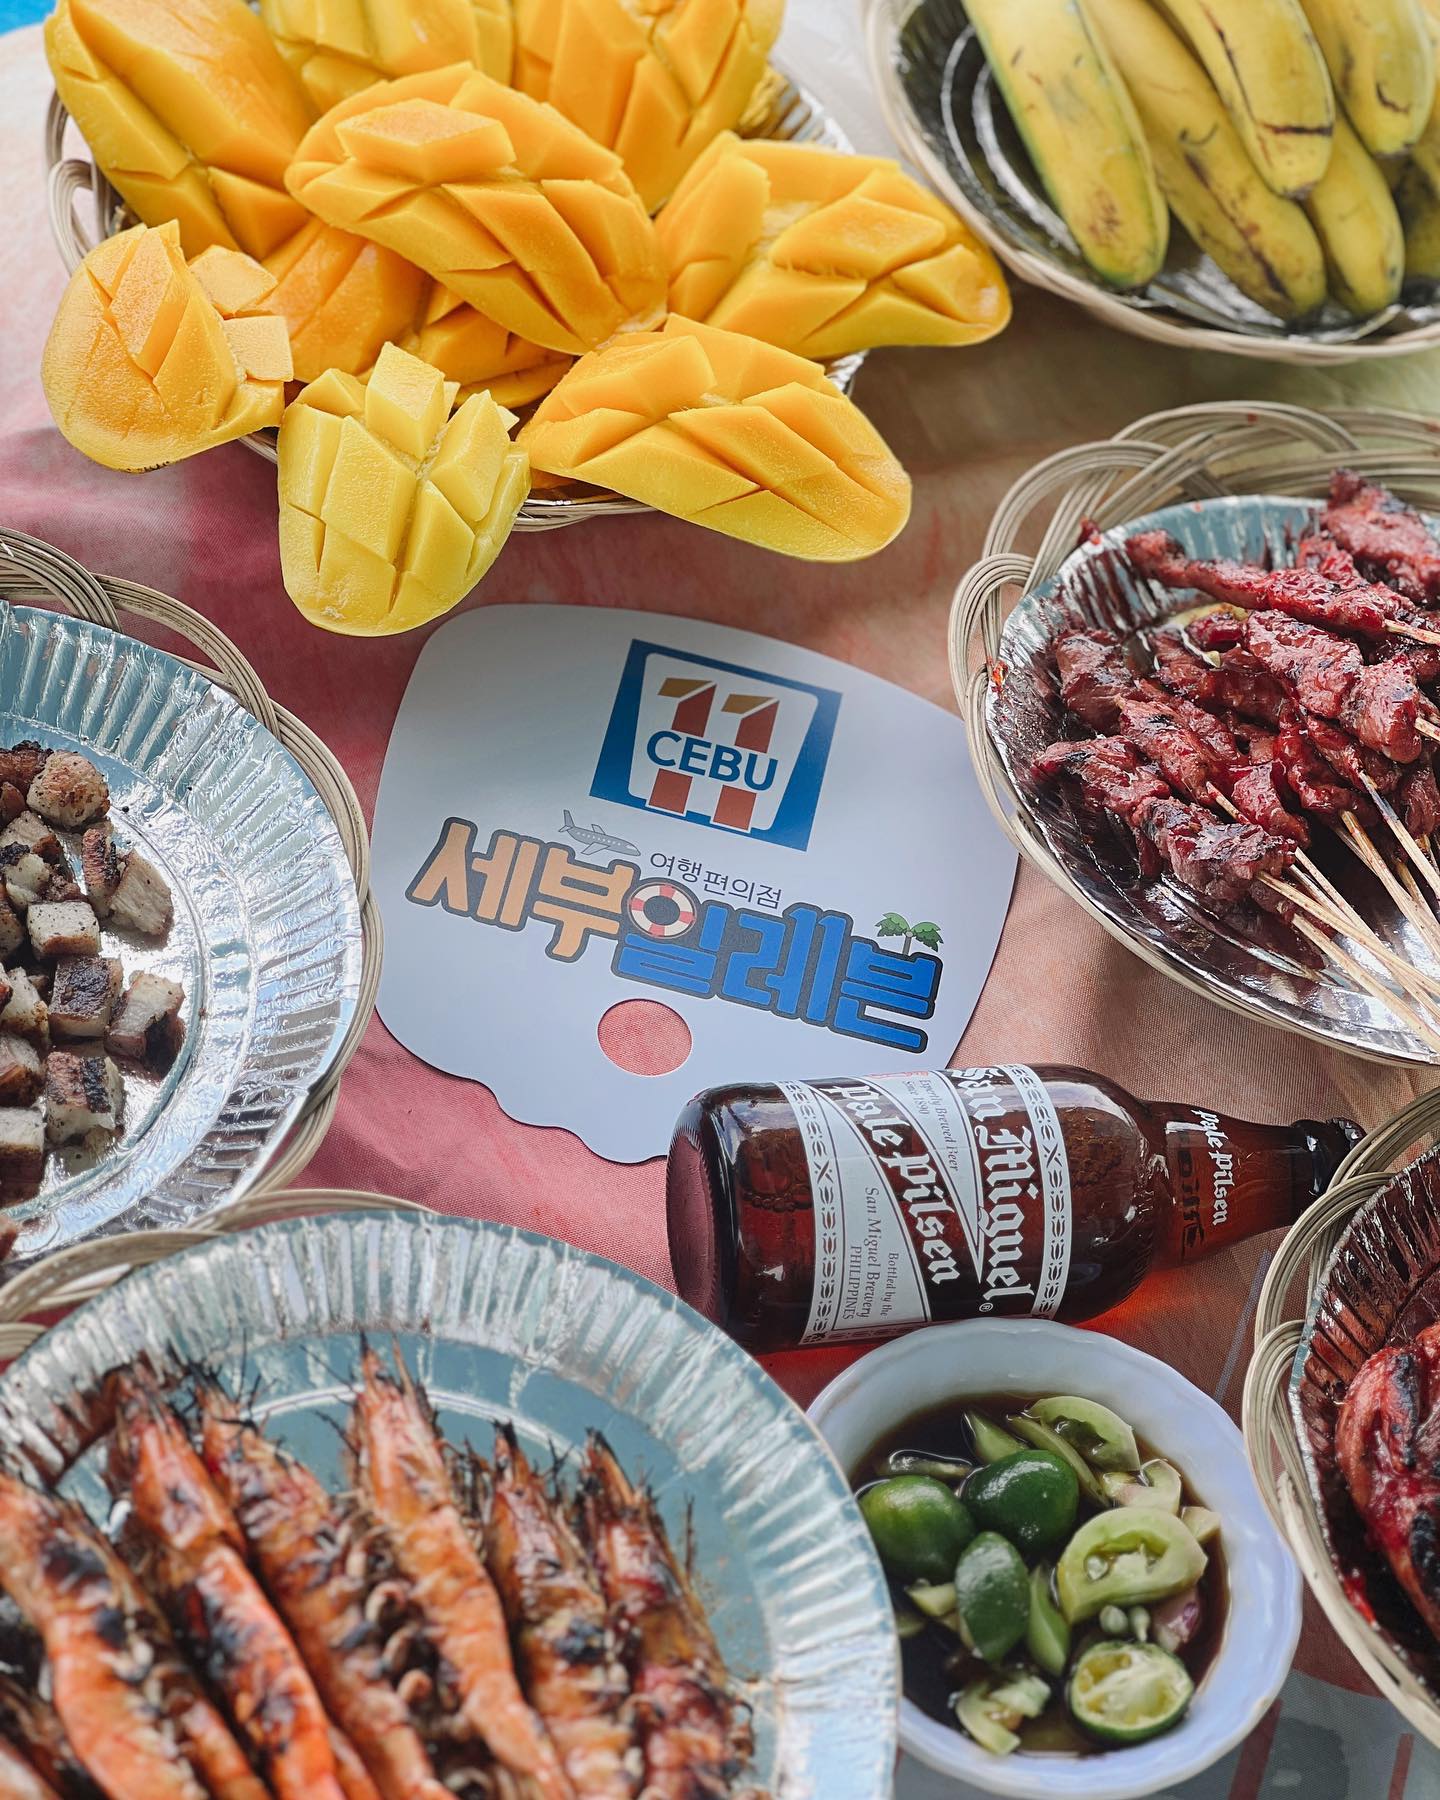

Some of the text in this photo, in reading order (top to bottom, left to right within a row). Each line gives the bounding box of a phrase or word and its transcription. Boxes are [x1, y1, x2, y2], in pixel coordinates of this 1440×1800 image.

[646, 730, 779, 792] CEBU
[913, 1097, 931, 1115] 1890
[935, 1107, 956, 1142] Brewed
[946, 1146, 960, 1171] Beer
[951, 1067, 1039, 1301] San Miguel
[842, 1246, 863, 1320] PHILIPPINES
[856, 1187, 882, 1318] San Miguel Brewery
[880, 1252, 900, 1317] Bottled by the
